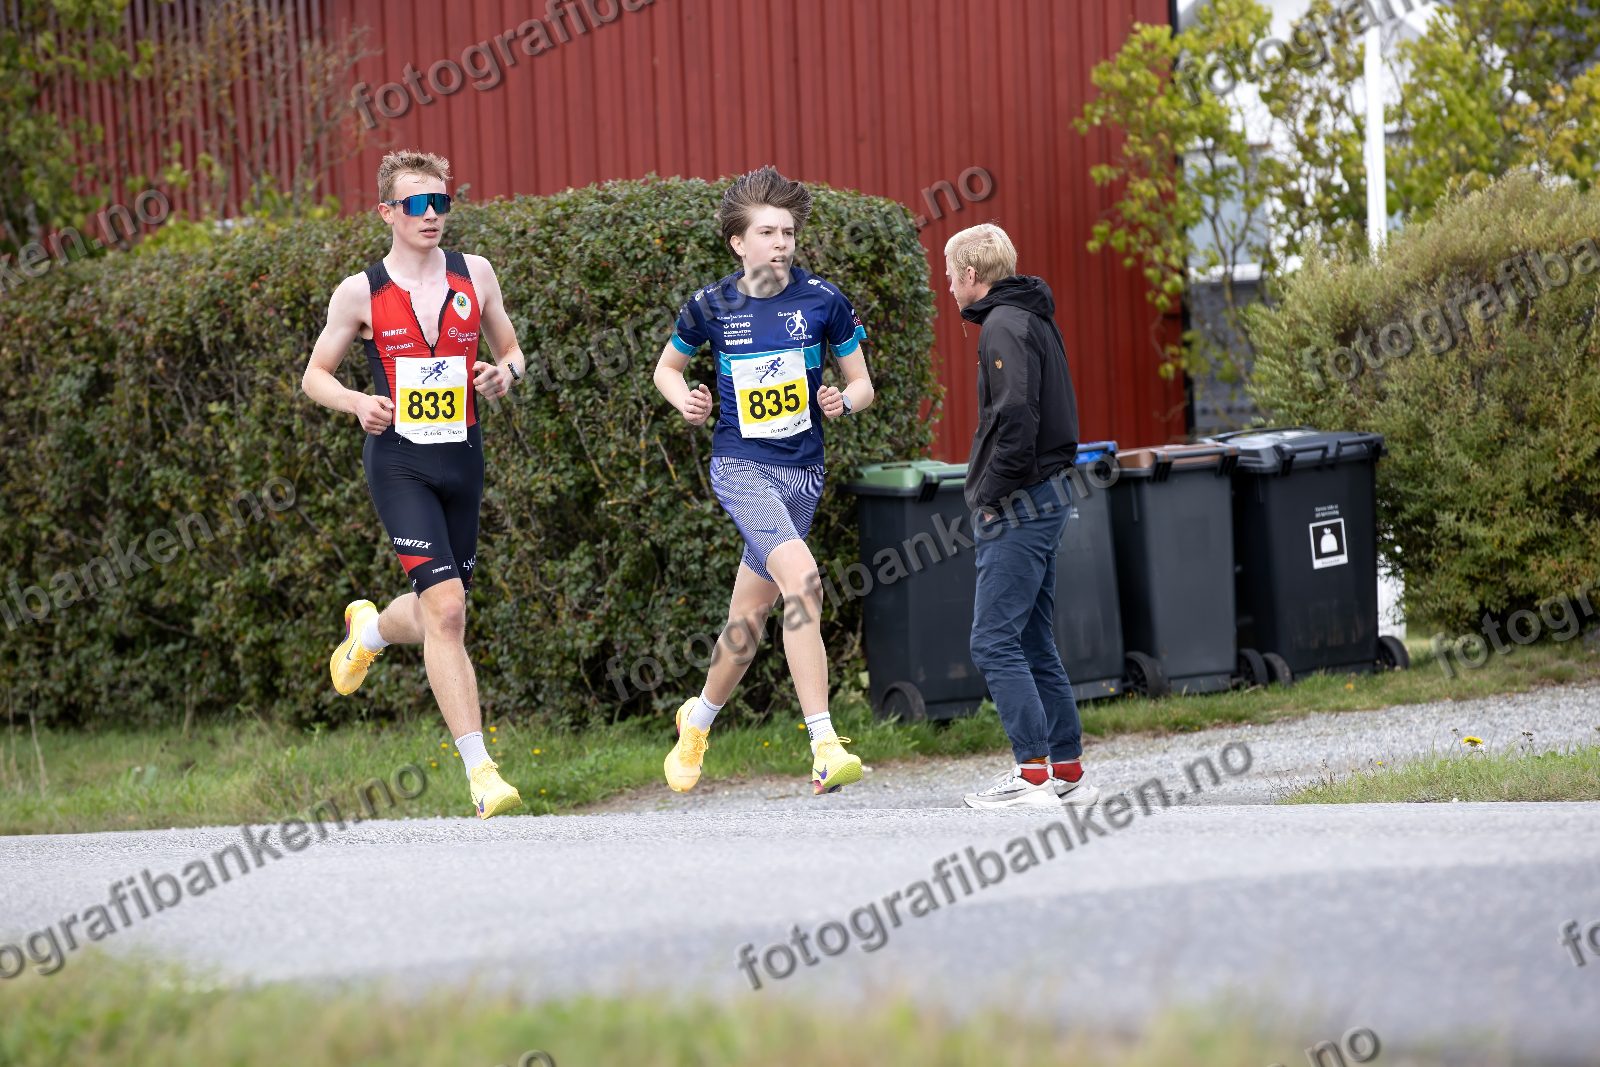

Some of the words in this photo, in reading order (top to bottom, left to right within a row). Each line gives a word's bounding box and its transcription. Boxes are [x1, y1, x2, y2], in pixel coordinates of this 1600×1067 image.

[381, 327, 408, 338] TRIMTEX
[407, 390, 456, 420] 833
[748, 384, 801, 419] 835
[393, 537, 432, 549] TRIMTEX
